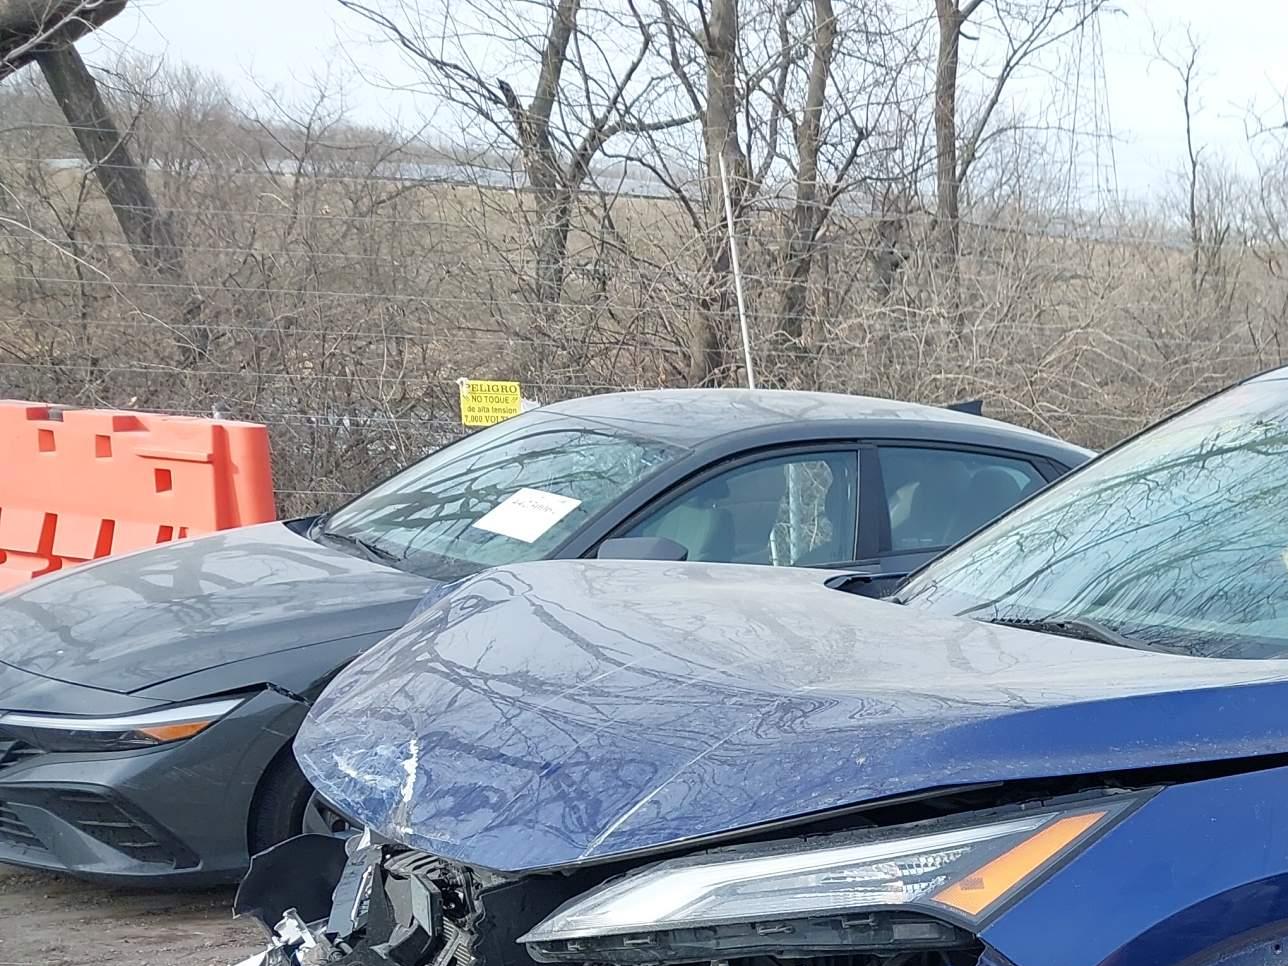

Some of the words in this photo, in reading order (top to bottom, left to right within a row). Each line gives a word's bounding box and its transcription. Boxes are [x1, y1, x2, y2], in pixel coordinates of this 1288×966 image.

[471, 395, 483, 403] NO
[484, 395, 510, 404] TOQUE
[484, 415, 508, 424] VOL
